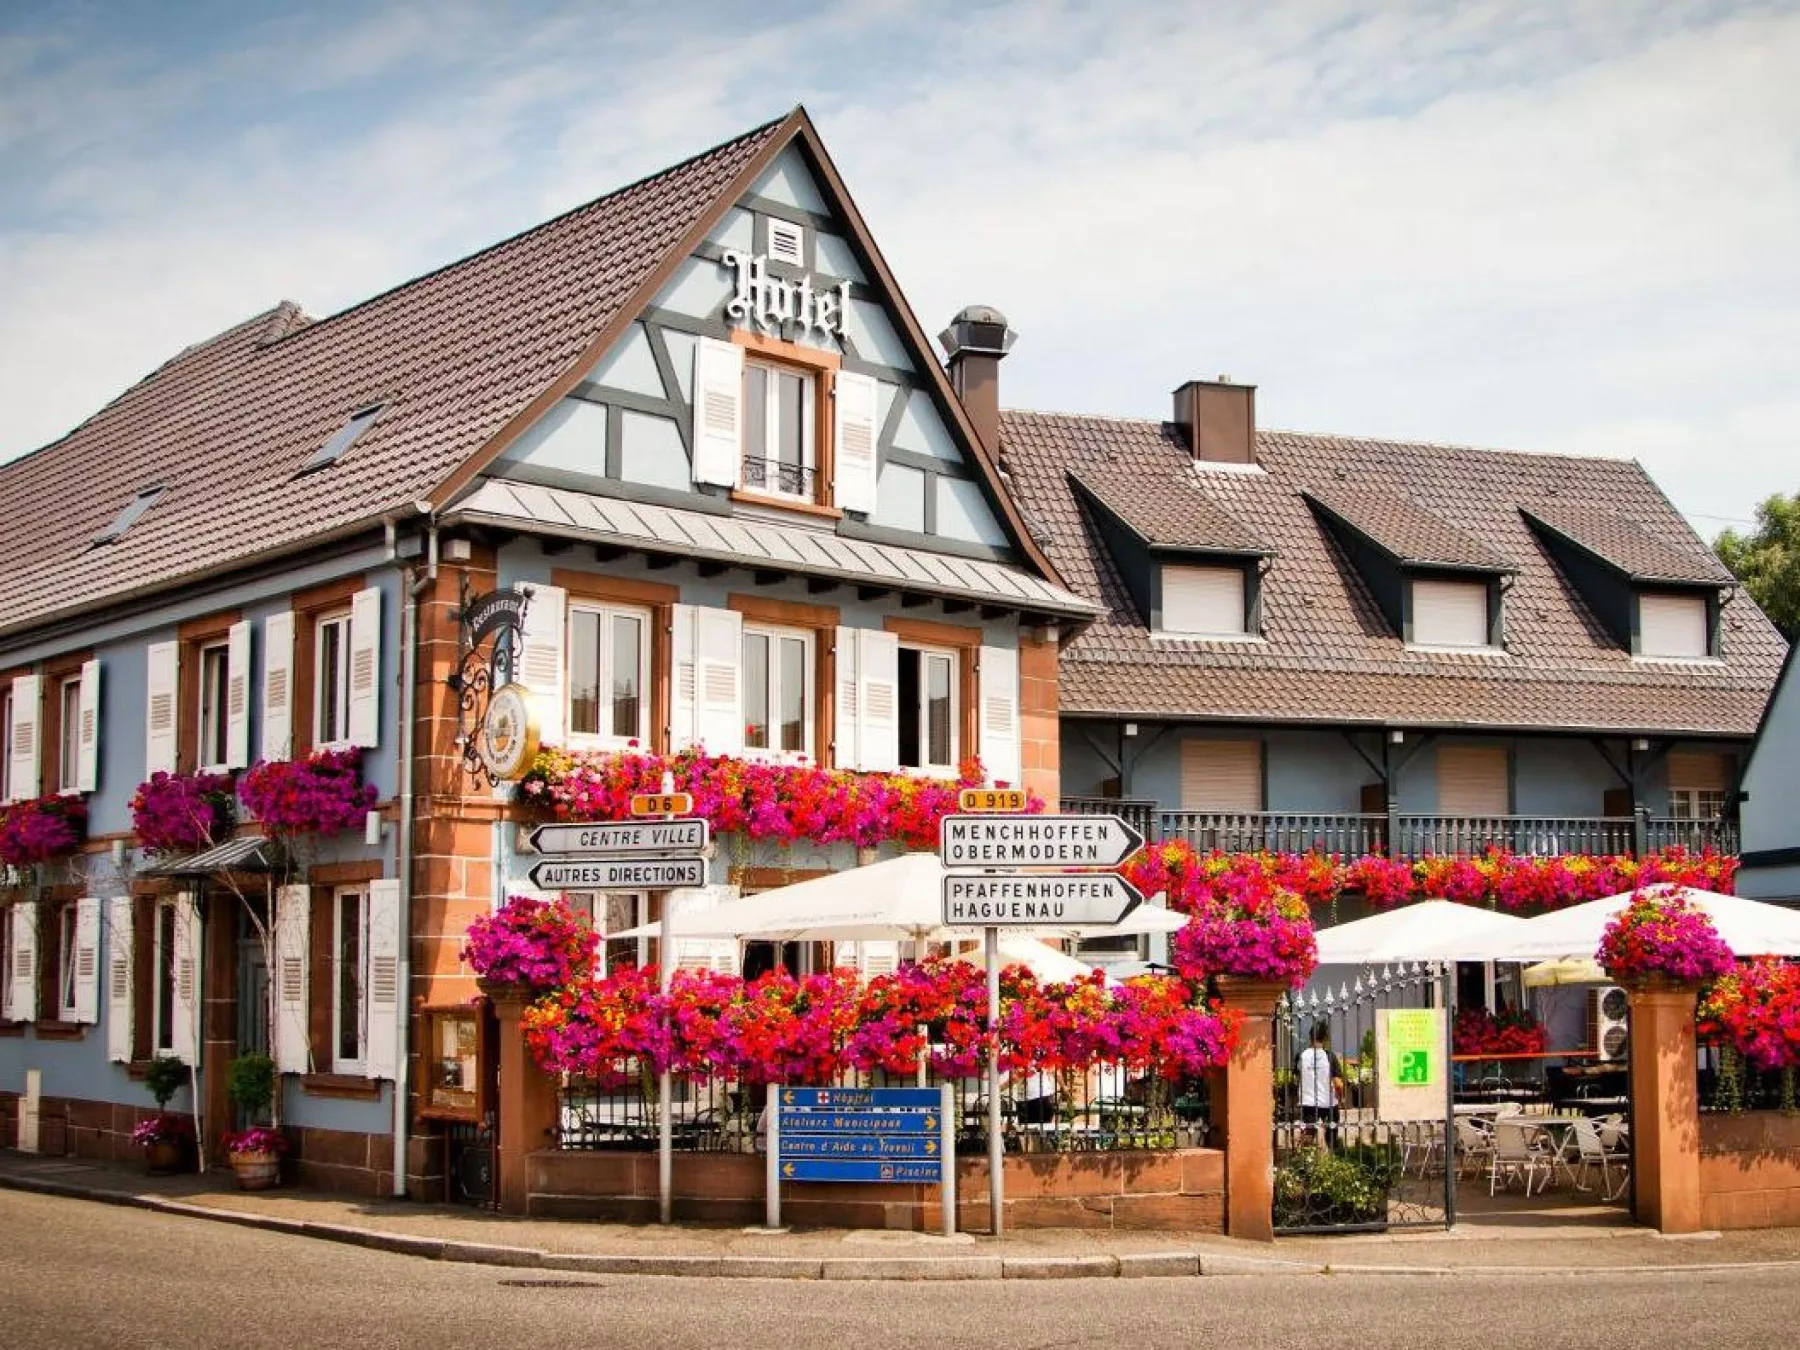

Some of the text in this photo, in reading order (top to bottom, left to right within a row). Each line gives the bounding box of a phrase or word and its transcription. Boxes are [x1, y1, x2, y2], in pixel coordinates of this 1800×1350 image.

[722, 251, 852, 340] Hotel
[580, 828, 697, 846] CENTRE VILLE
[953, 825, 1108, 840] MENCHHOFFEN
[953, 845, 1098, 860] OBERMODERN
[545, 867, 697, 882] AUTRES DIRECTIONS
[953, 883, 1114, 898] PFAFFENHOFFEN
[953, 903, 1065, 918] HAGUENAU
[781, 1140, 816, 1150] Centre
